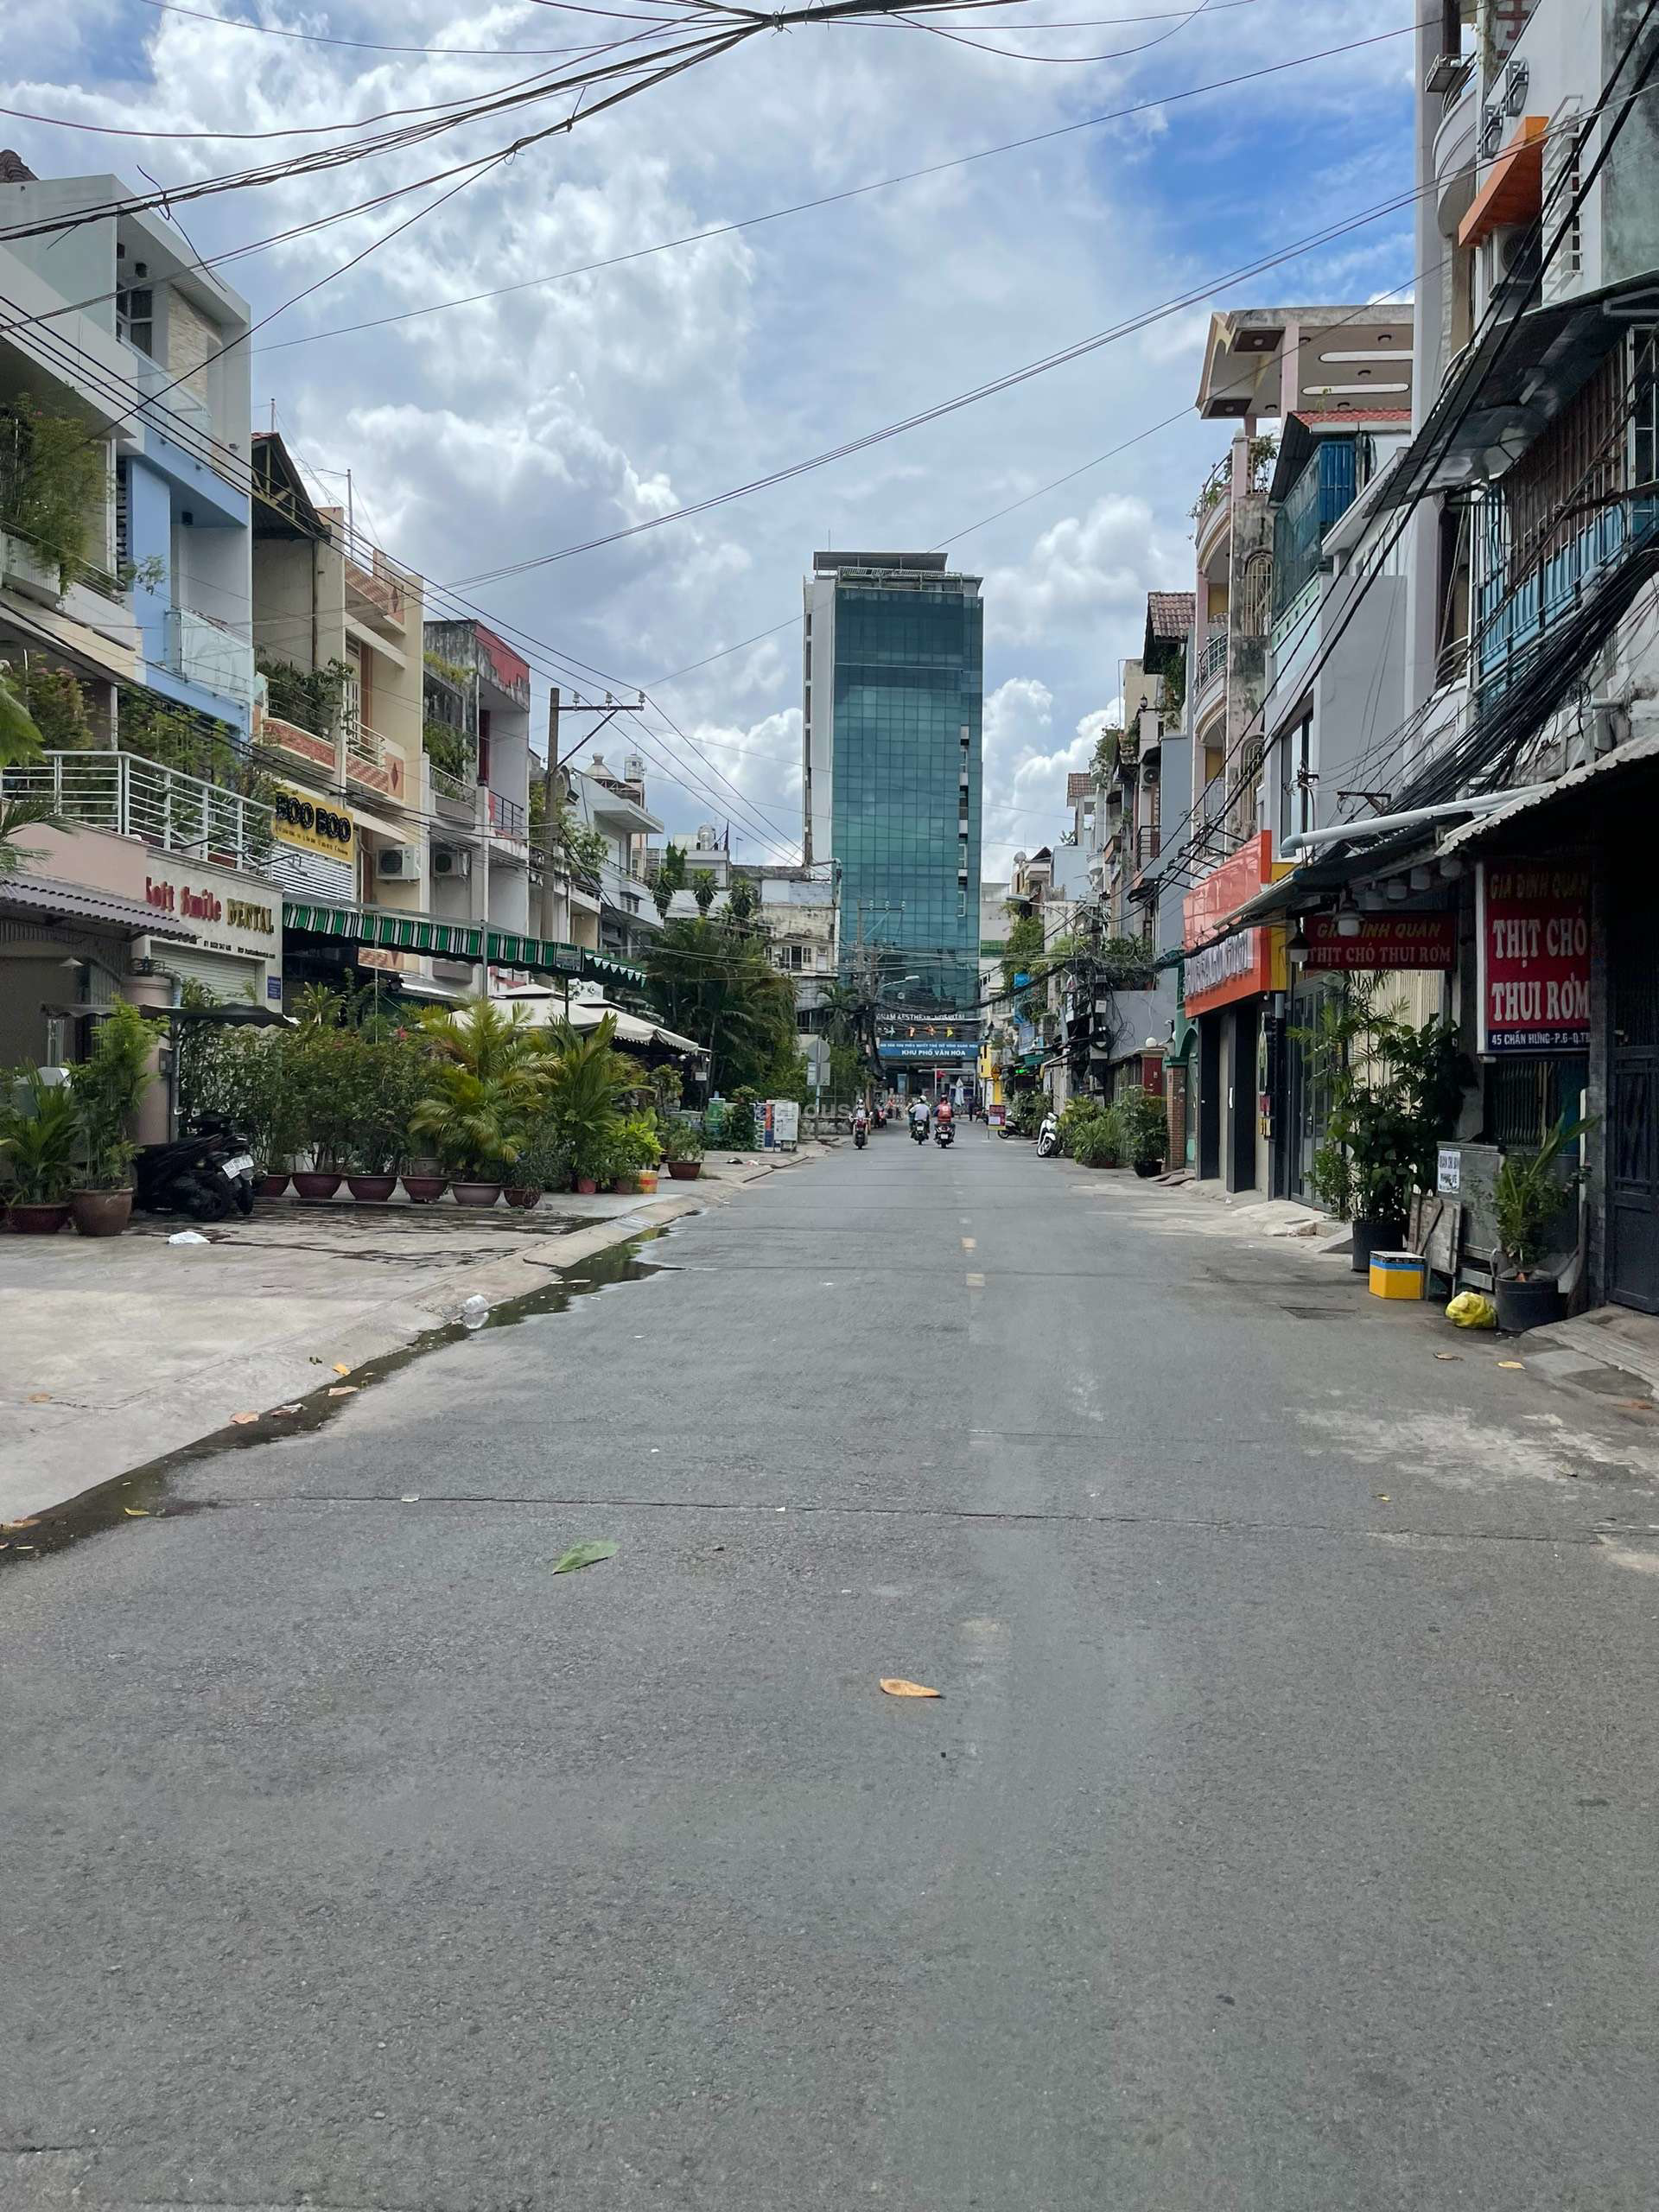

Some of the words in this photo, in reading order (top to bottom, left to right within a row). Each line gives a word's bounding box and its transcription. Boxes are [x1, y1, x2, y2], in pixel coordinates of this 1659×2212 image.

[276, 792, 315, 830] BOO
[315, 807, 352, 843] BOO
[1309, 945, 1342, 967] THỊT
[1345, 941, 1375, 963] CHÓ
[1379, 946, 1415, 963] THUI
[1418, 944, 1452, 963] RƠM
[1493, 919, 1541, 968] THỊT
[1546, 906, 1587, 957] CHÓ
[1491, 981, 1541, 1021] THUI
[1546, 972, 1590, 1020] RƠM
[1491, 1033, 1502, 1045] 45
